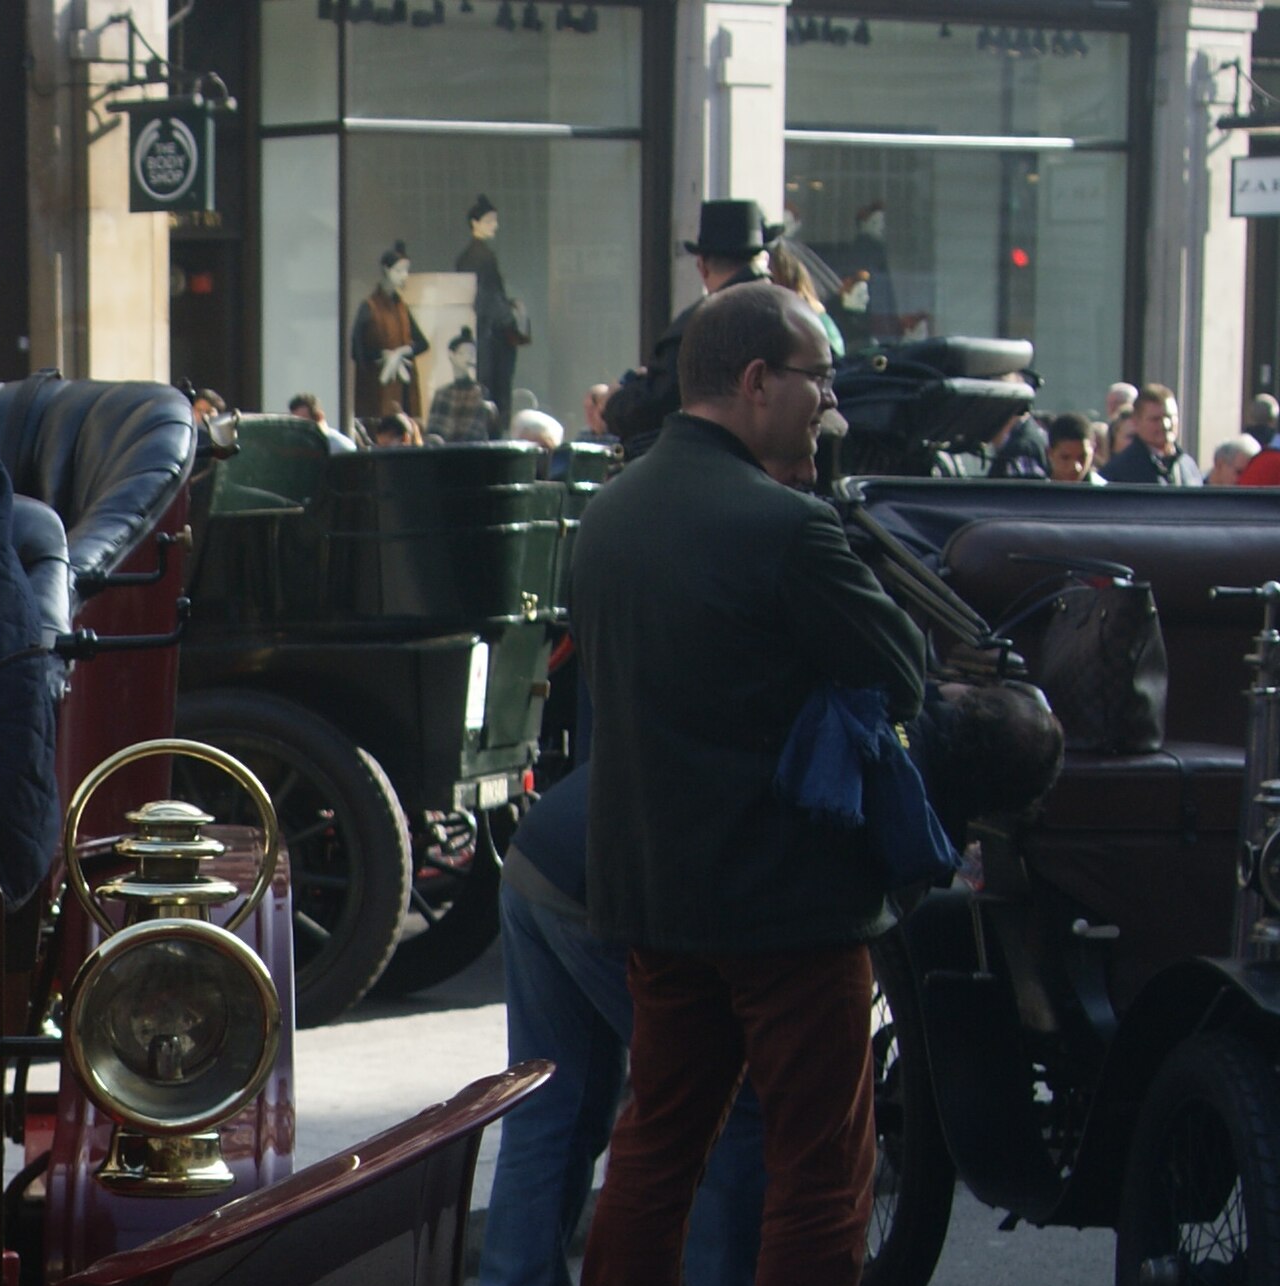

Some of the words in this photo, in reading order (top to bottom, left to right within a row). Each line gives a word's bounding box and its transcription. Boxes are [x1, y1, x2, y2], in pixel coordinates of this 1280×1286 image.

[155, 142, 175, 153] THE
[147, 155, 185, 169] BODY
[149, 169, 184, 184] SHOP
